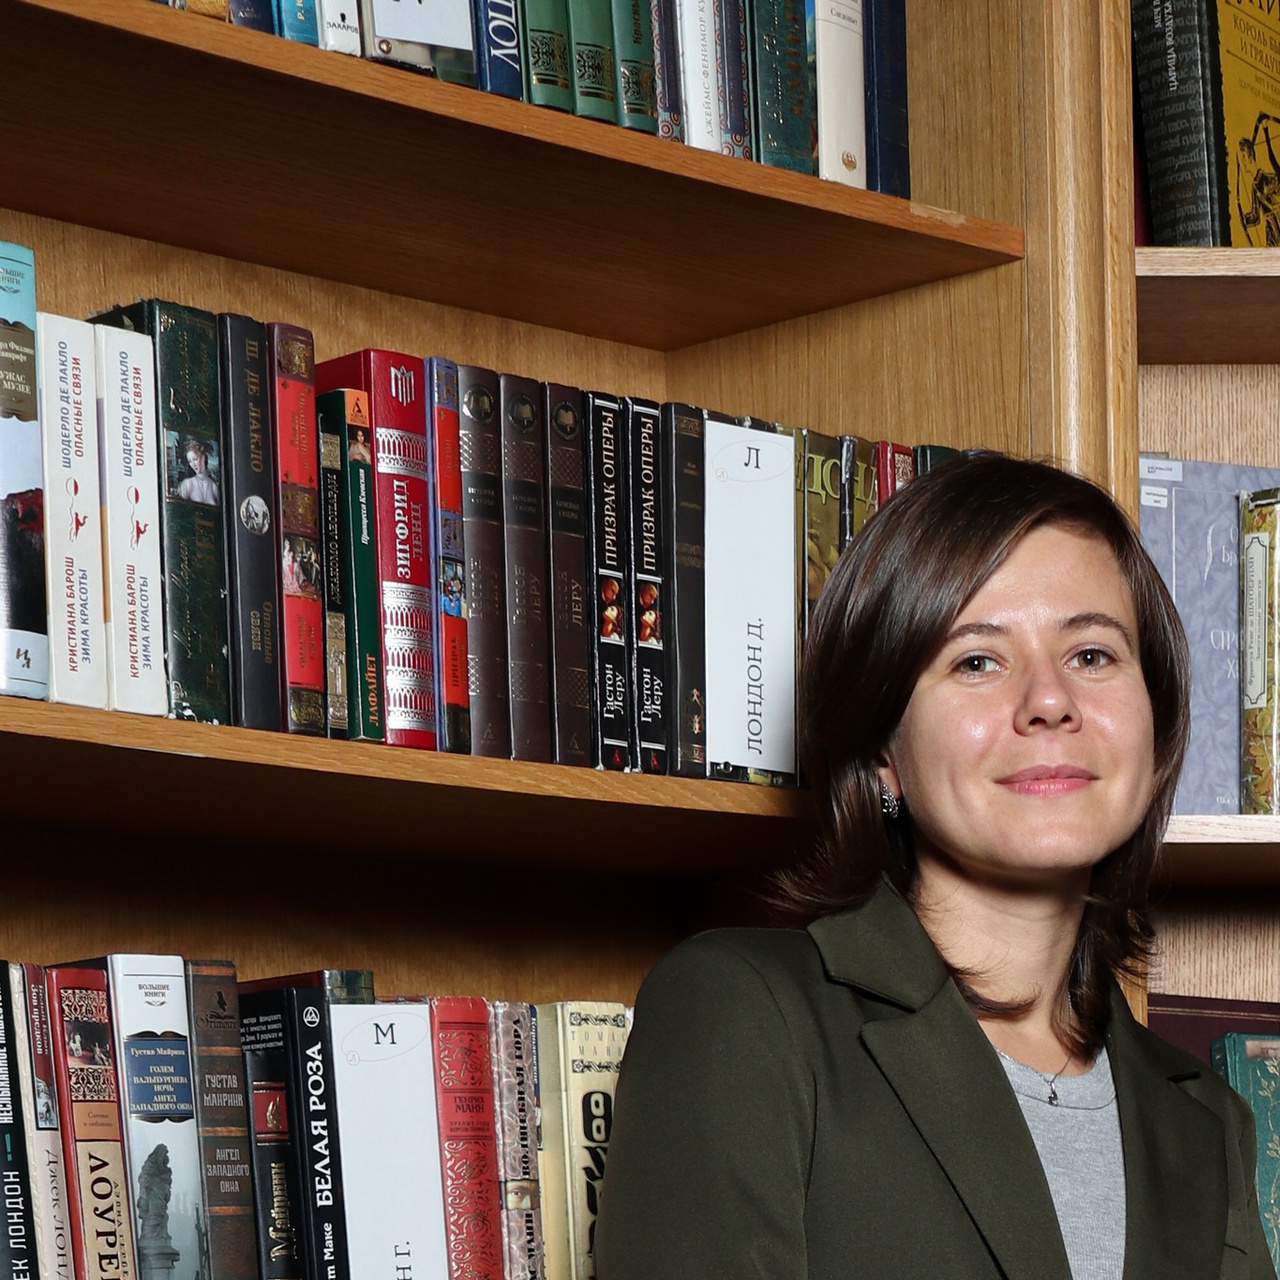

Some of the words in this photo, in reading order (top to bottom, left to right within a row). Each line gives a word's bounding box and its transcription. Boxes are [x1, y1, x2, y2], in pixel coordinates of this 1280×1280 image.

[700, 19, 712, 79] ФЕНИМОР
[1232, 13, 1268, 46] КОРОЛЬ
[1239, 38, 1248, 53] И
[1166, 41, 1179, 92] ЦАРИЦА
[703, 84, 713, 137] ДЖЕЙМС
[58, 340, 69, 390] ЛАКЛО
[71, 356, 82, 396] СВЯЗИ
[118, 350, 130, 397] ЛАКЛО
[132, 366, 143, 403] СВЯЗИ
[60, 393, 70, 406] ДЕ
[120, 401, 131, 413] ДЕ
[60, 408, 72, 469] ШОДЕРЛО
[72, 398, 84, 458] ОПАСНЫЕ
[121, 415, 134, 477] ШОДЕРЛО
[135, 406, 146, 466] ОПАСНЫЕ
[602, 410, 616, 479] ОПЕРЫ
[640, 416, 654, 485] ОПЕРЫ
[743, 446, 761, 470] Л
[392, 478, 411, 579] ЗИГФРИД
[410, 502, 423, 562] ЛЕНЦ
[603, 483, 618, 567] ПРИЗРАК
[641, 489, 656, 571] ПРИЗРАК
[64, 556, 77, 600] БАРОШ
[78, 568, 90, 625] КРАСОТЫ
[125, 563, 137, 607] БАРОШ
[139, 575, 150, 634] КРАСОТЫ
[66, 602, 79, 672] КРИСТИАНА
[81, 628, 91, 664] ЗИМА
[126, 609, 140, 678] КРИСТИАНА
[142, 636, 152, 670] ЗИМА
[747, 617, 764, 641] Д.
[365, 653, 379, 726] ЛАФАЙЕТ
[602, 663, 615, 719] Гастон
[613, 671, 626, 715] Леру
[640, 667, 652, 722] Гастон
[650, 675, 663, 719] Леру
[747, 644, 764, 755] ЛОНДОН
[372, 1022, 398, 1045] М
[511, 1018, 524, 1061] ГОРА
[149, 1064, 175, 1074] ГОЛЕМ
[153, 1084, 175, 1092] НОЧЬ
[204, 1074, 239, 1089] ГУСТАВ
[304, 1040, 327, 1113] РОЗА
[152, 1094, 177, 1103] АНГЕЛ
[203, 1093, 244, 1108] МАЙРИНК
[454, 1104, 485, 1114] МАНН
[514, 1067, 532, 1177] ВОЛШЕБНАЯ
[206, 1163, 250, 1176] ЗАПАДНОГО
[215, 1148, 241, 1161] АНГЕЛ
[310, 1118, 335, 1209] БЕЛАЯ
[45, 1148, 61, 1210] Джек
[219, 1180, 240, 1193] ОКНА
[2, 1171, 28, 1250] ЛОНДОН
[323, 1222, 334, 1262] Маке
[394, 1240, 411, 1259] Г.
[523, 1212, 534, 1261] МАНН
